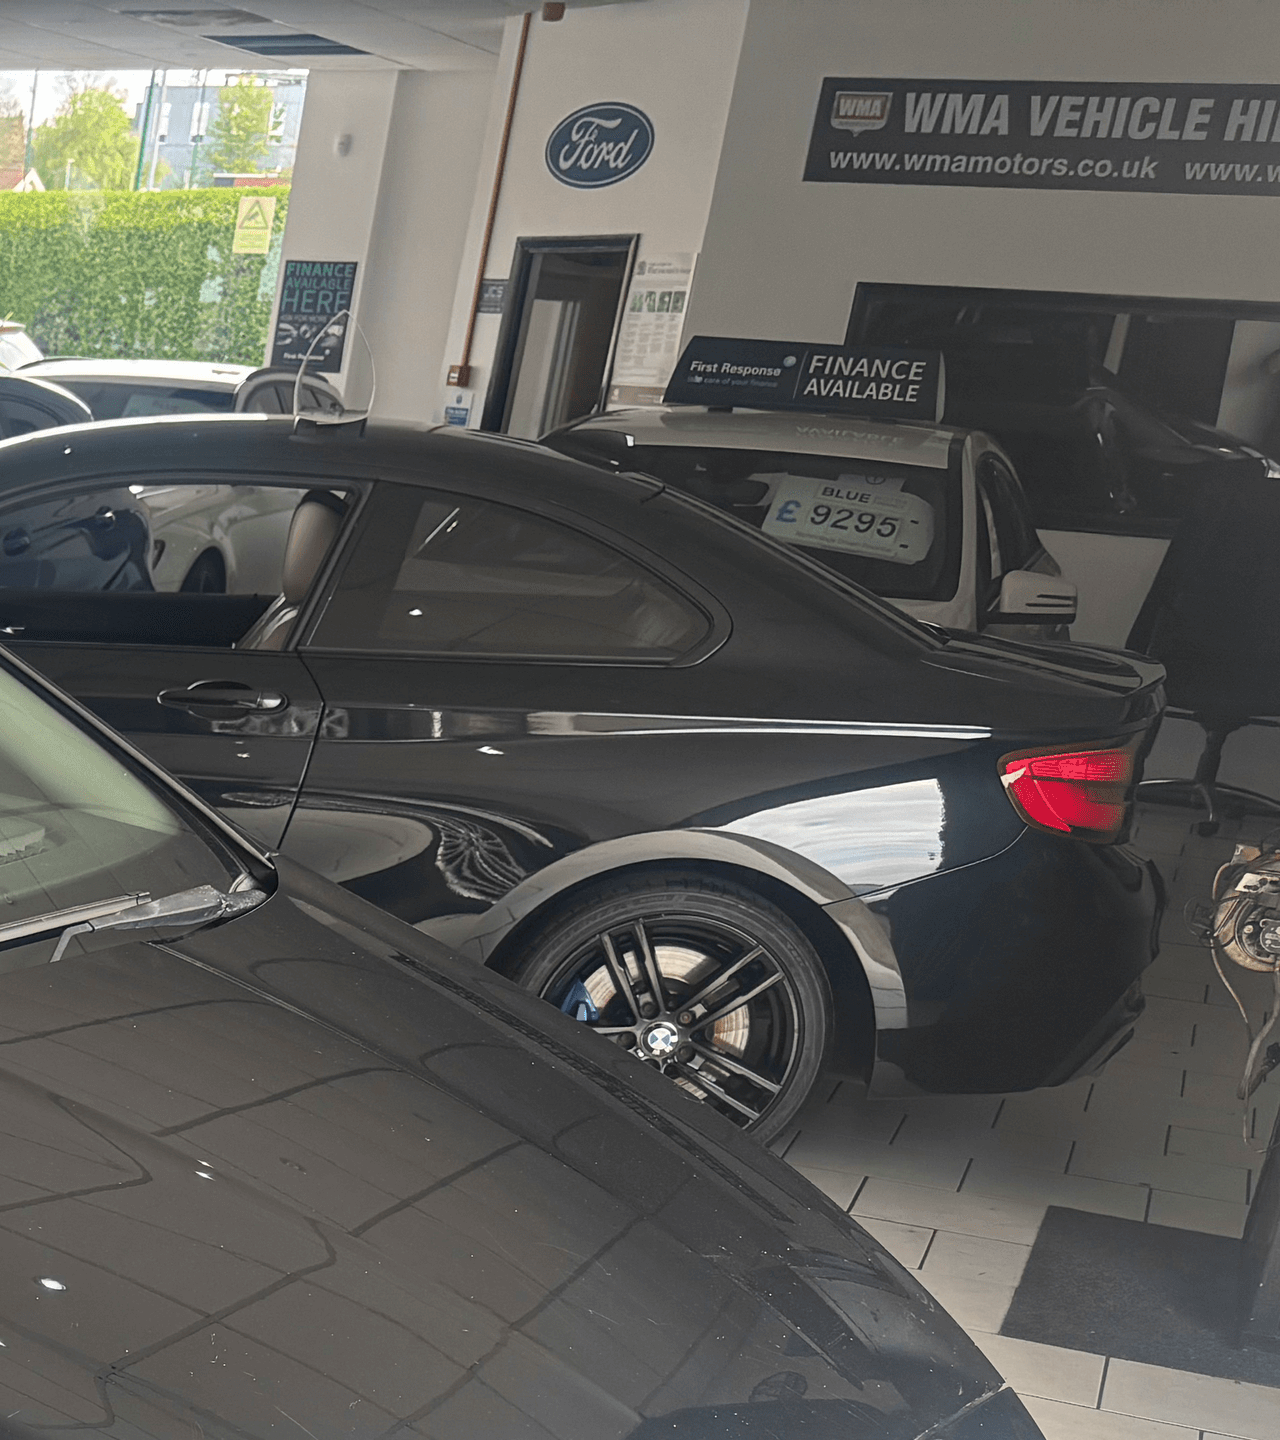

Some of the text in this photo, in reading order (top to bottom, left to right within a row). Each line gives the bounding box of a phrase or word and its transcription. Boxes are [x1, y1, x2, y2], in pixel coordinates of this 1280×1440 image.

[839, 98, 883, 117] WMA
[904, 91, 1009, 136] WMA
[1030, 95, 1215, 141] VEHICLE
[559, 116, 639, 171] Ford
[829, 150, 1159, 180] www.wmamotors.co.uk
[286, 262, 354, 277] FINANCE
[281, 289, 350, 314] HERE
[690, 360, 782, 377] First Response
[808, 354, 927, 381] FINANCE
[803, 377, 920, 403] AVAILABLE
[821, 486, 872, 503] BLUE
[775, 499, 802, 523] £
[810, 504, 899, 538] 9295
